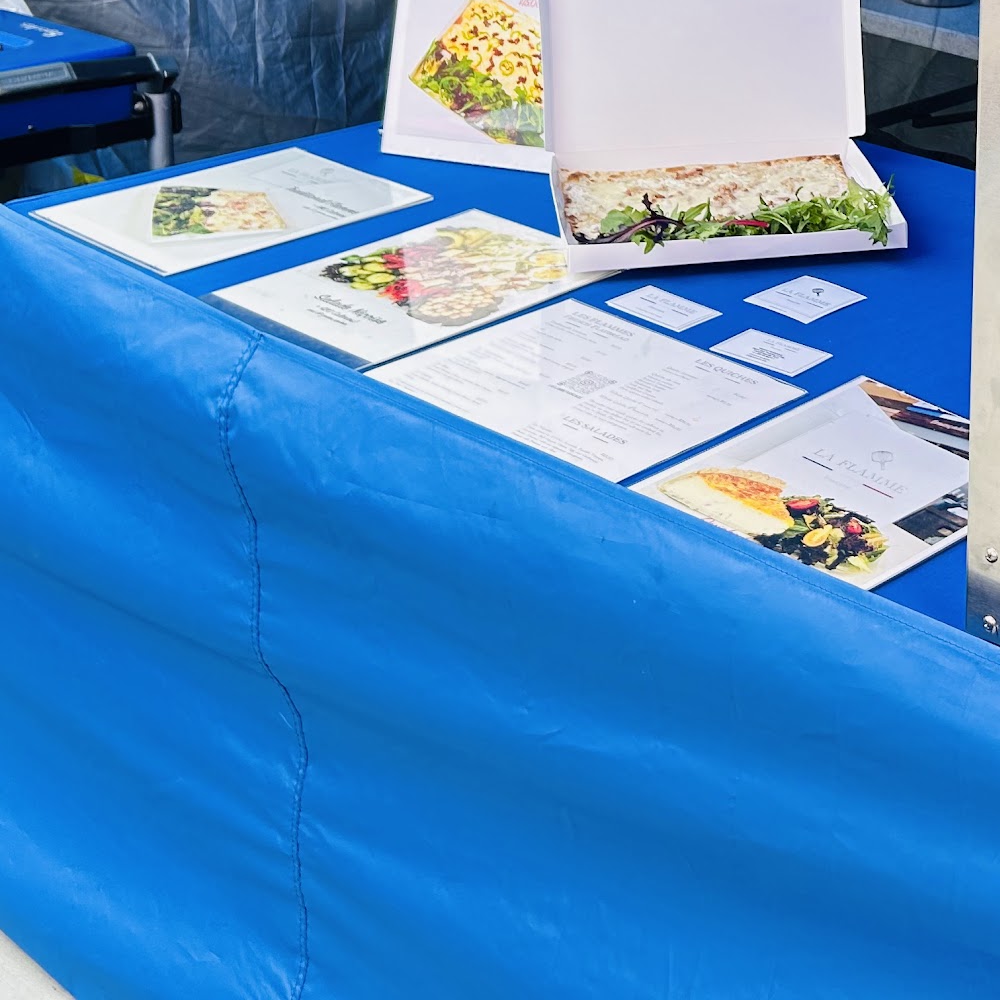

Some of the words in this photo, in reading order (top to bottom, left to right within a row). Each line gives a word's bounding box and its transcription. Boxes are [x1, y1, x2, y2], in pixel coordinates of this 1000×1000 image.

[694, 359, 713, 368] LES
[713, 366, 759, 385] QUICHES
[562, 415, 581, 427] LES
[582, 423, 628, 445] SALADES
[813, 448, 836, 462] LA
[836, 459, 908, 494] FLAMME
